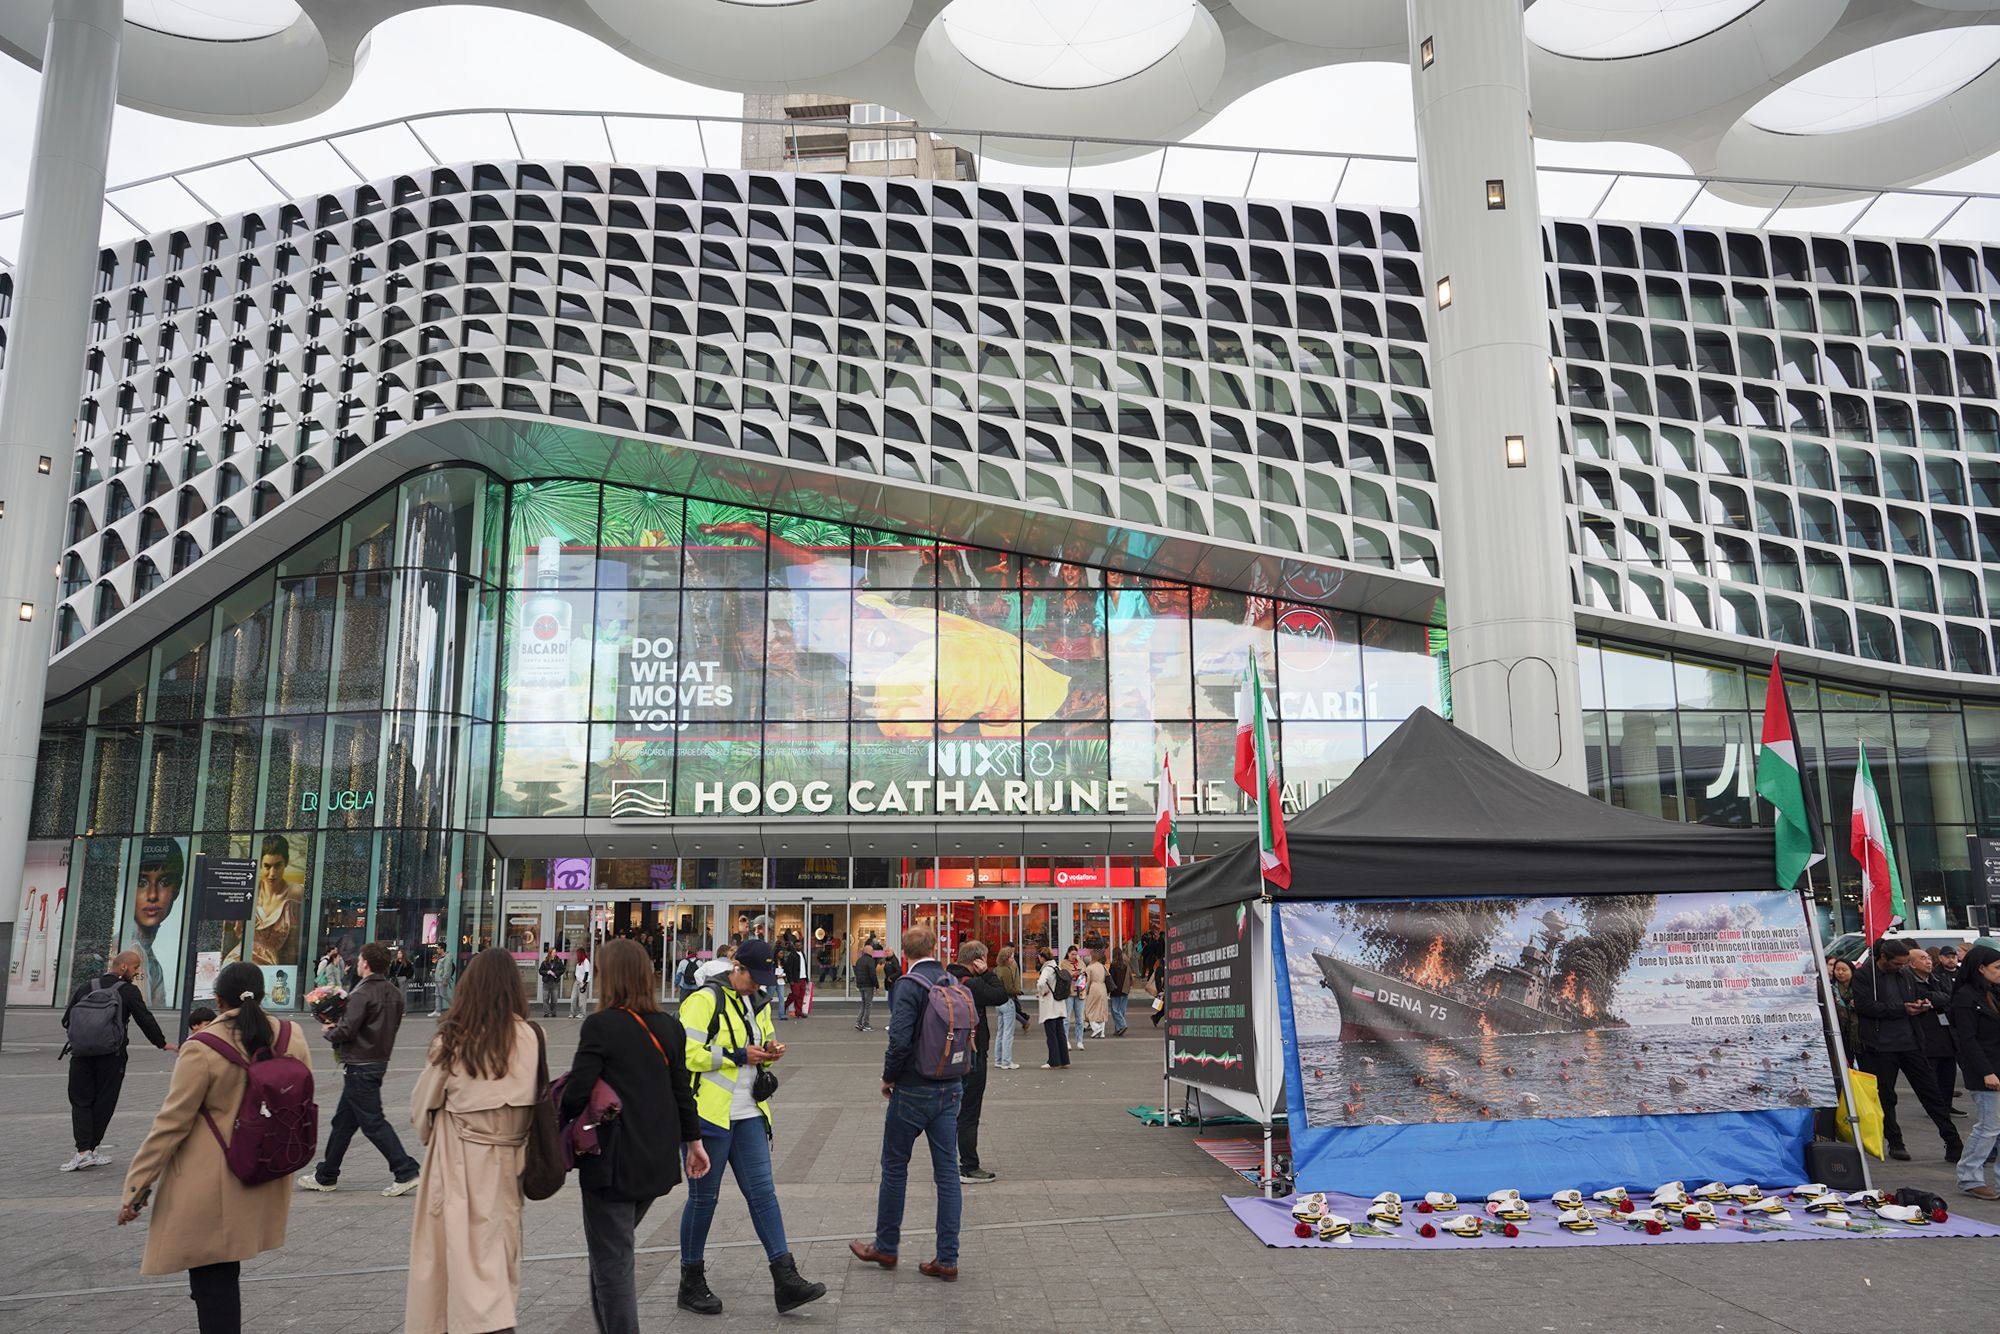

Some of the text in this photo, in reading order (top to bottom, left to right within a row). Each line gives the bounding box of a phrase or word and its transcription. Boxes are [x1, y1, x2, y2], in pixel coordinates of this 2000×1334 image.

[631, 637, 674, 659] DO
[630, 661, 721, 683] WHAT
[629, 685, 734, 707] MOVES
[1234, 681, 1378, 720] ACARDÍ
[628, 709, 690, 732] YOU
[928, 742, 1055, 777] NIX18
[694, 780, 834, 814] HOOG
[848, 780, 1129, 813] CATHARIJNE
[1653, 928, 1799, 942] A blatant barbaric crime in open waters
[1668, 940, 1800, 954] Killing of 104 innocent Iranian lives
[1638, 956, 1657, 967] Done
[1657, 955, 1668, 967] by
[1669, 955, 1684, 965] USA
[1684, 955, 1694, 964] as
[1695, 954, 1701, 964] if
[1702, 954, 1708, 963] it
[1710, 954, 1725, 963] was
[1726, 954, 1737, 963] an
[1686, 976, 1807, 989] Shame on Trump! Shame on USA!
[1377, 988, 1448, 1021] DENA 75
[1691, 1012, 1813, 1026] 4th of march 2026, Indian Ocean
